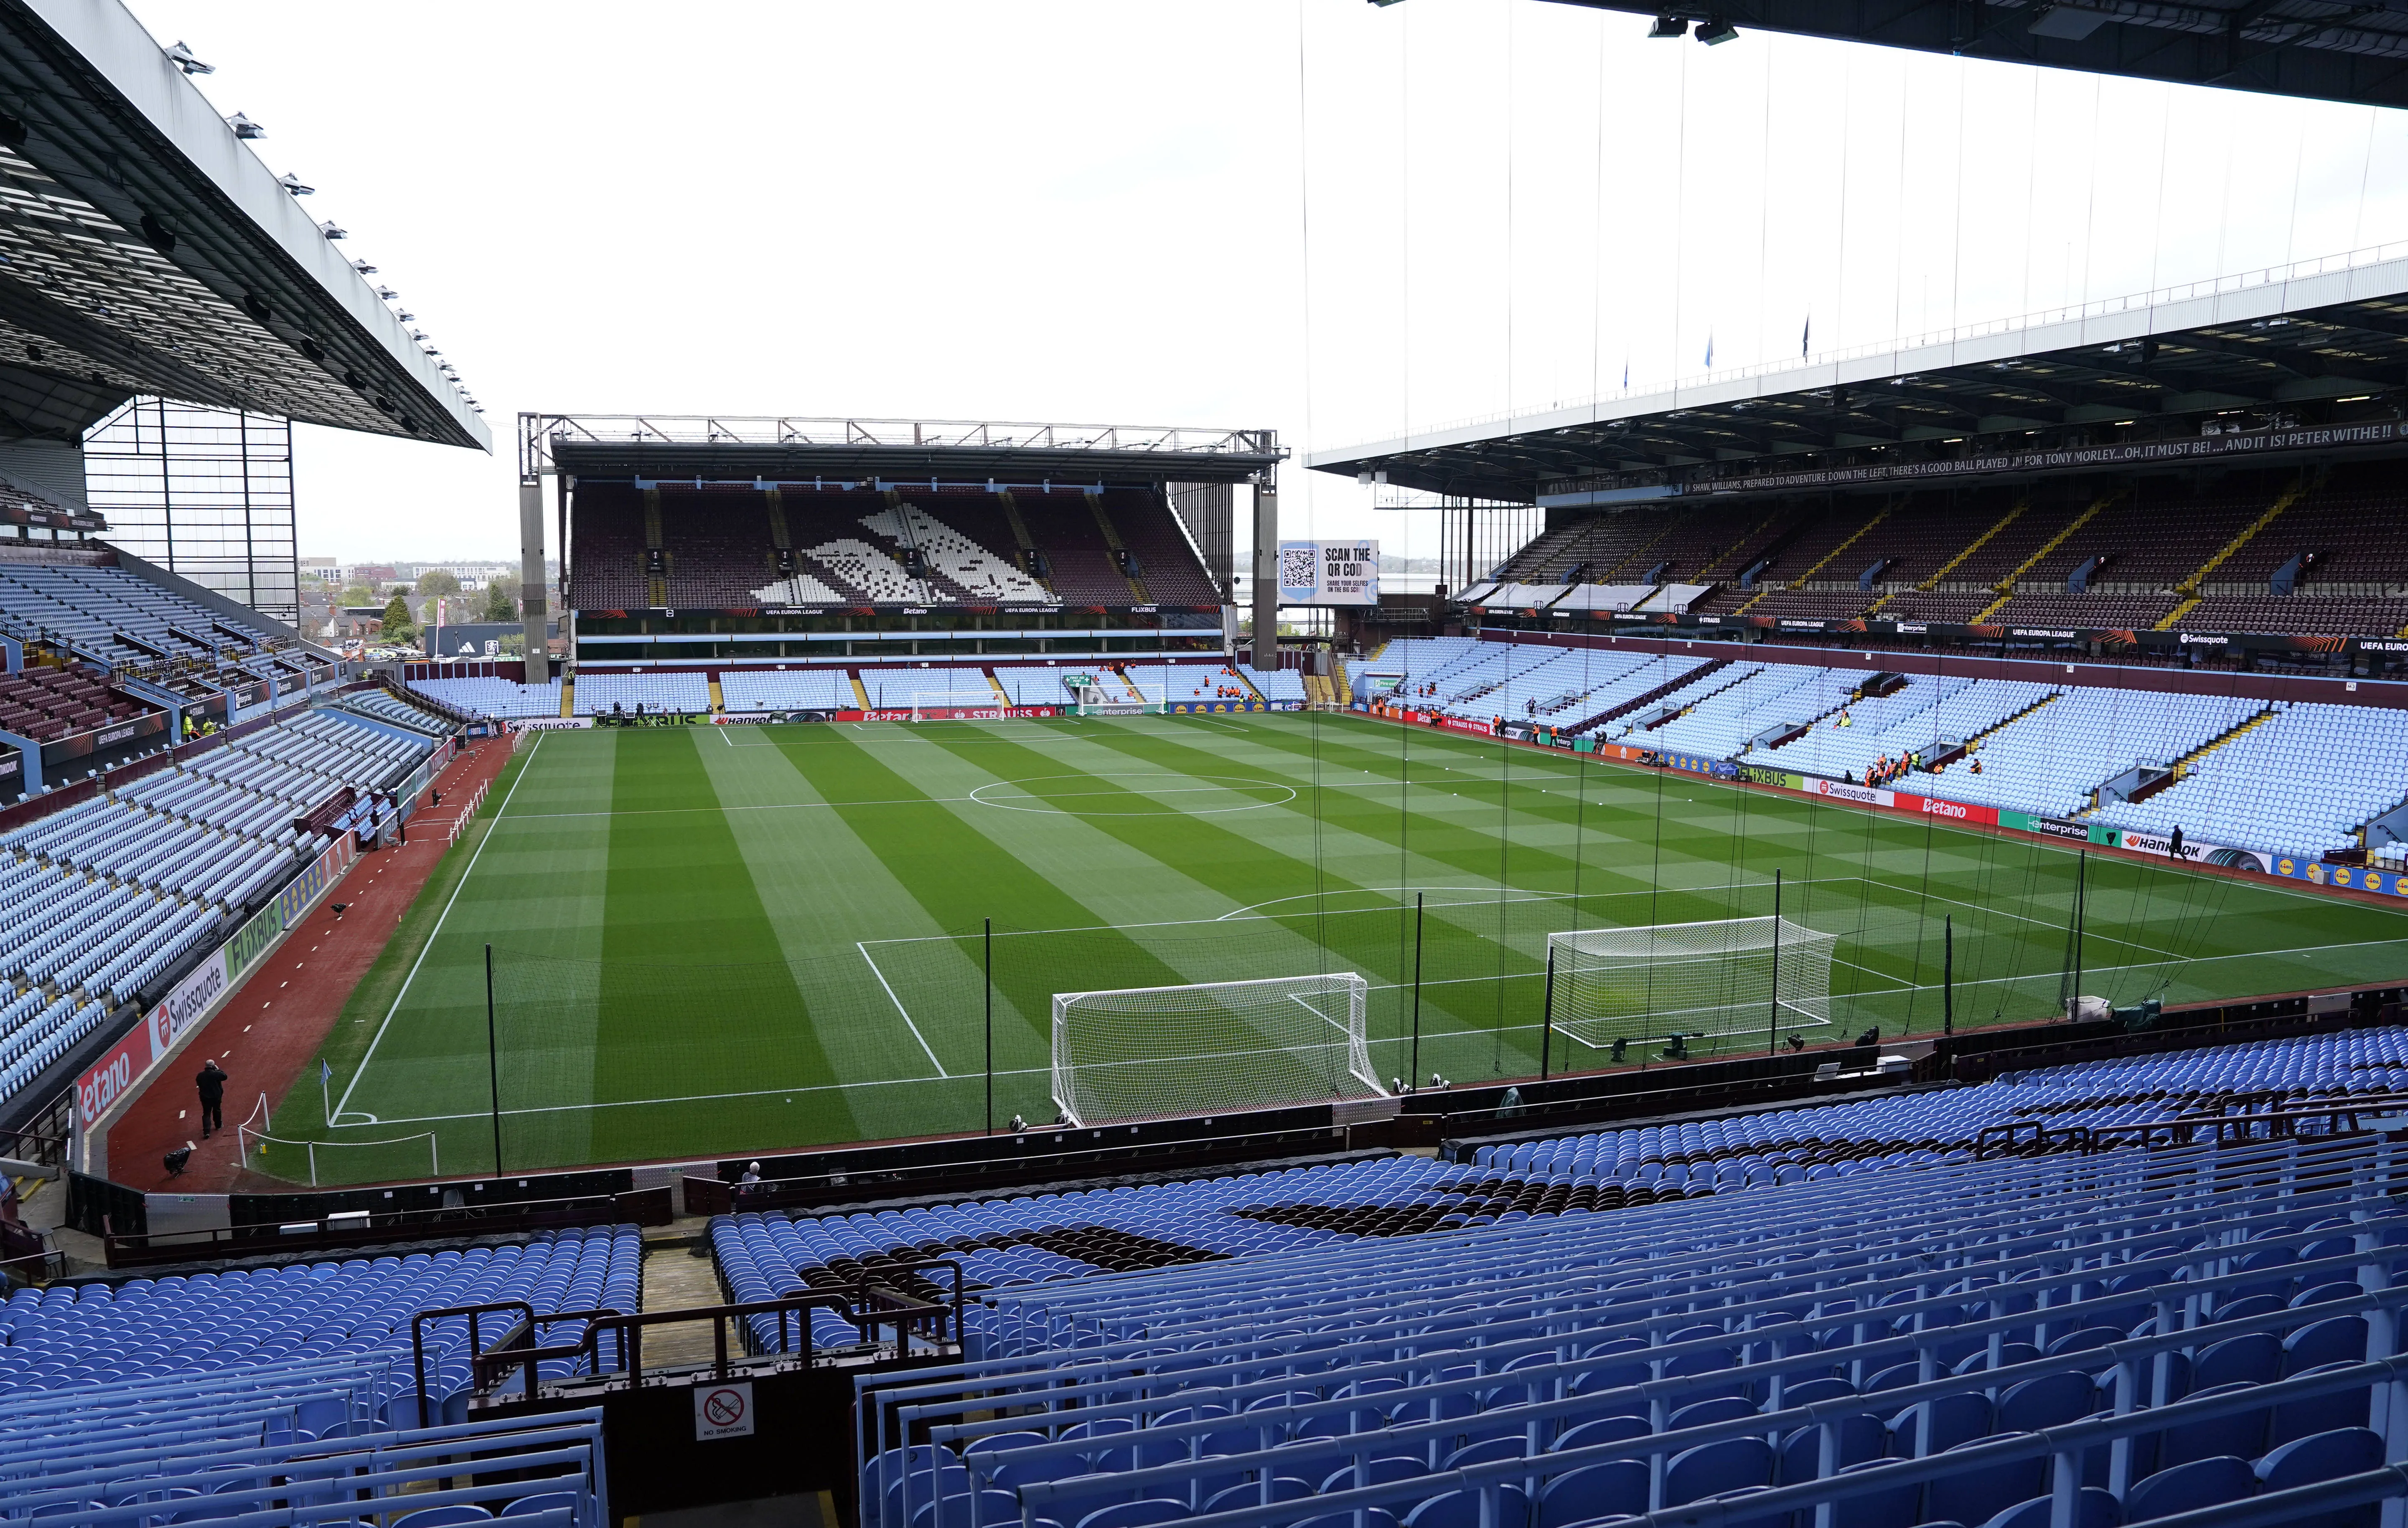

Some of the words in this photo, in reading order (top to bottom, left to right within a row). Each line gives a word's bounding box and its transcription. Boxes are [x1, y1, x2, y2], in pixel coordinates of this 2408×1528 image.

[1693, 484, 1711, 493] SHAW,
[1712, 480, 1742, 491] WILLIAMS,
[1743, 477, 1774, 488] PREPARED
[1776, 476, 1785, 485] TO
[1785, 472, 1826, 485] ADVENTURE
[1828, 471, 1852, 481] DOWN
[1853, 470, 1867, 478] THE
[1889, 464, 1919, 476] THERE'S
[1920, 464, 1926, 473] A
[1928, 462, 1952, 473] GOOD
[1954, 460, 1975, 470] BALL
[1976, 457, 2008, 469] PLAYED
[2012, 457, 2023, 466] IN
[2025, 455, 2043, 466] FOR
[2045, 452, 2072, 464] TONY
[2075, 449, 2123, 462] MORLEY...
[2124, 447, 2144, 459] OH,
[2145, 446, 2156, 457] IT
[2157, 443, 2189, 455] MUST
[2192, 441, 2210, 452] BE!
[2225, 437, 2253, 450] AND
[2254, 437, 2264, 448] IT
[2270, 434, 2285, 447] IS!
[2288, 431, 2330, 445] PETER
[2332, 426, 2379, 441] WITHE
[1325, 548, 1350, 561] SCAN
[1353, 548, 1370, 561] THE
[1328, 563, 1340, 577] QR
[2189, 634, 2228, 645] Swissquote
[2360, 642, 2383, 650] UEFA
[193, 706, 204, 716] STRAUSS
[973, 710, 1033, 718] STRAUSS
[1452, 720, 1468, 728] STRAUSS
[98, 733, 108, 745] UEFA
[108, 729, 122, 741] EUROPA
[122, 726, 135, 739] LEAGUE
[468, 727, 487, 736] #FOOTBALL
[1829, 784, 1875, 802] Swissquote
[1923, 798, 1966, 818] Betano
[2032, 820, 2088, 837] enterprise
[170, 966, 221, 1033] Swissquote
